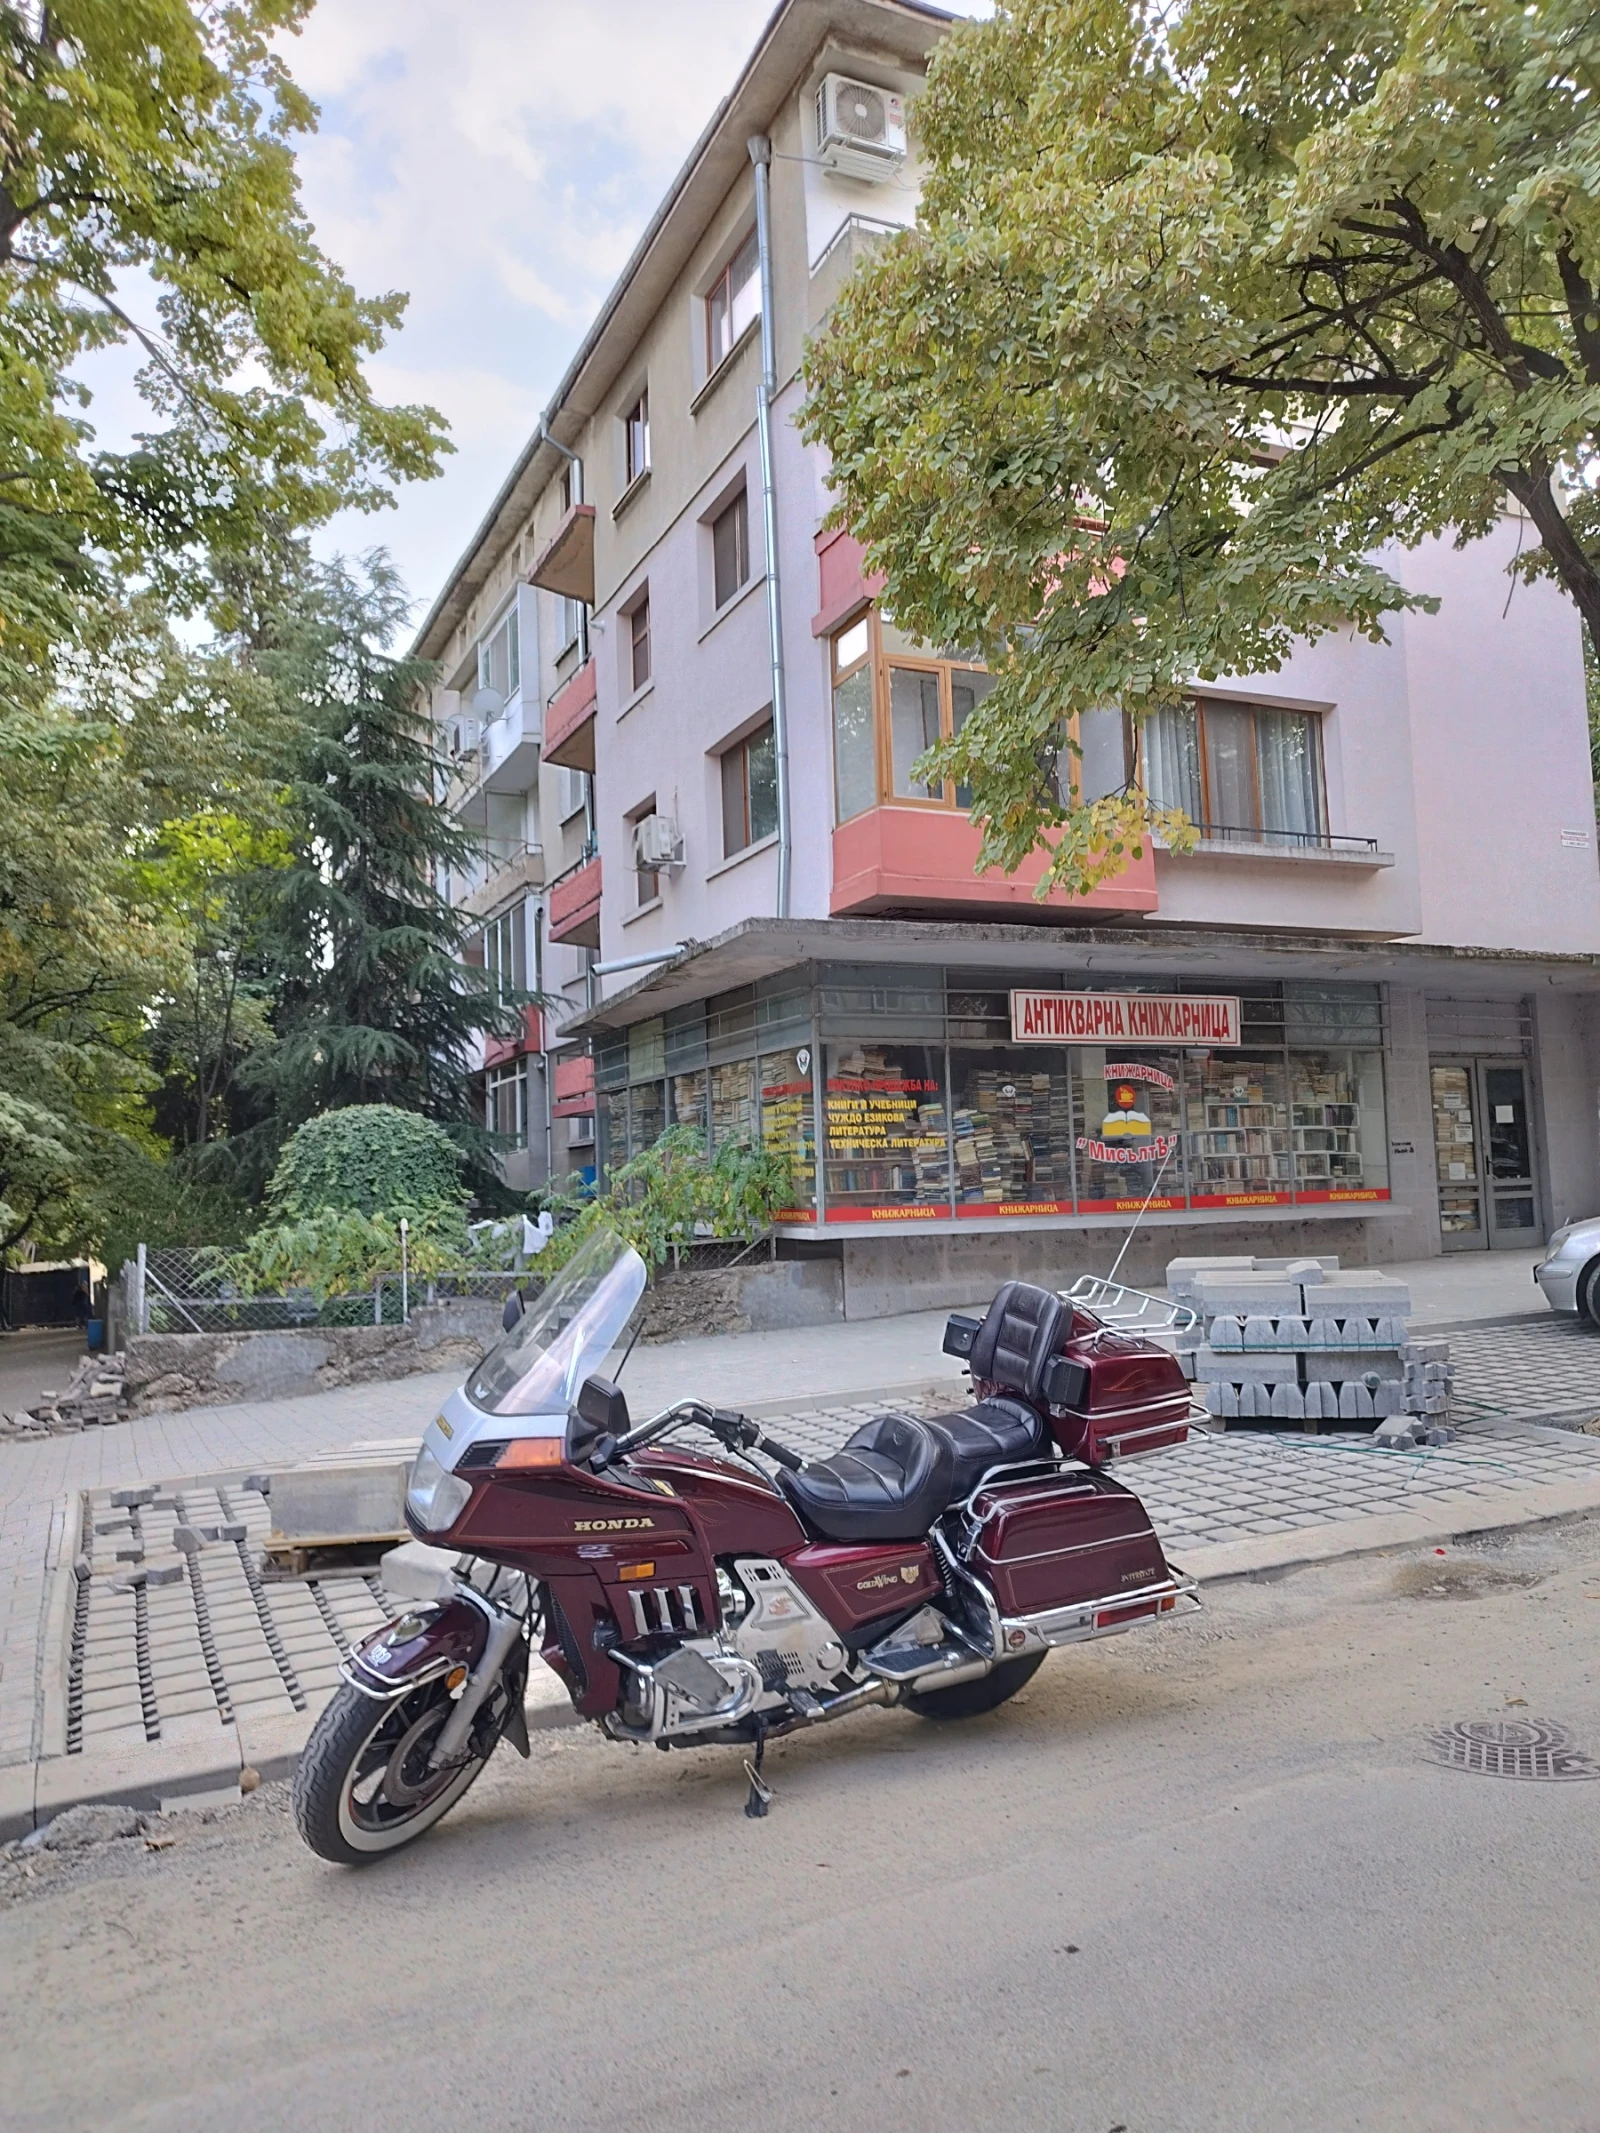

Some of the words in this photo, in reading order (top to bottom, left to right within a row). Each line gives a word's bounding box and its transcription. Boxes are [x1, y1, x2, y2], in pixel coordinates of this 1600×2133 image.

[1023, 997, 1125, 1036] АНТИКВАРНА
[1128, 1001, 1230, 1040] КНИЖАРНИЦА
[1104, 1064, 1175, 1091] КНИЖАРНИЦА
[827, 1099, 859, 1110] КНИГИ
[860, 1099, 868, 1110] И
[869, 1099, 917, 1111] УЧЕБНИЦИ
[828, 1112, 863, 1124] ЧУЖДО
[864, 1112, 905, 1123] ЕЗИКОВА
[829, 1125, 887, 1136] ЛИТЕРАТУРА
[829, 1138, 888, 1150] ТЕХНИЧЕСКА
[890, 1137, 946, 1149] ЛИТЕРАТУРА
[1226, 1194, 1278, 1205] КНИЖАРНИЦА
[1329, 1191, 1378, 1200] КНИЖАРНИЦА
[999, 1204, 1059, 1215] КНИЖАРНИЦА
[1116, 1199, 1172, 1210] КНИЖАРНИЦА
[872, 1207, 936, 1219] КНИЖАРНИЦА
[574, 1517, 655, 1531] HONDA
